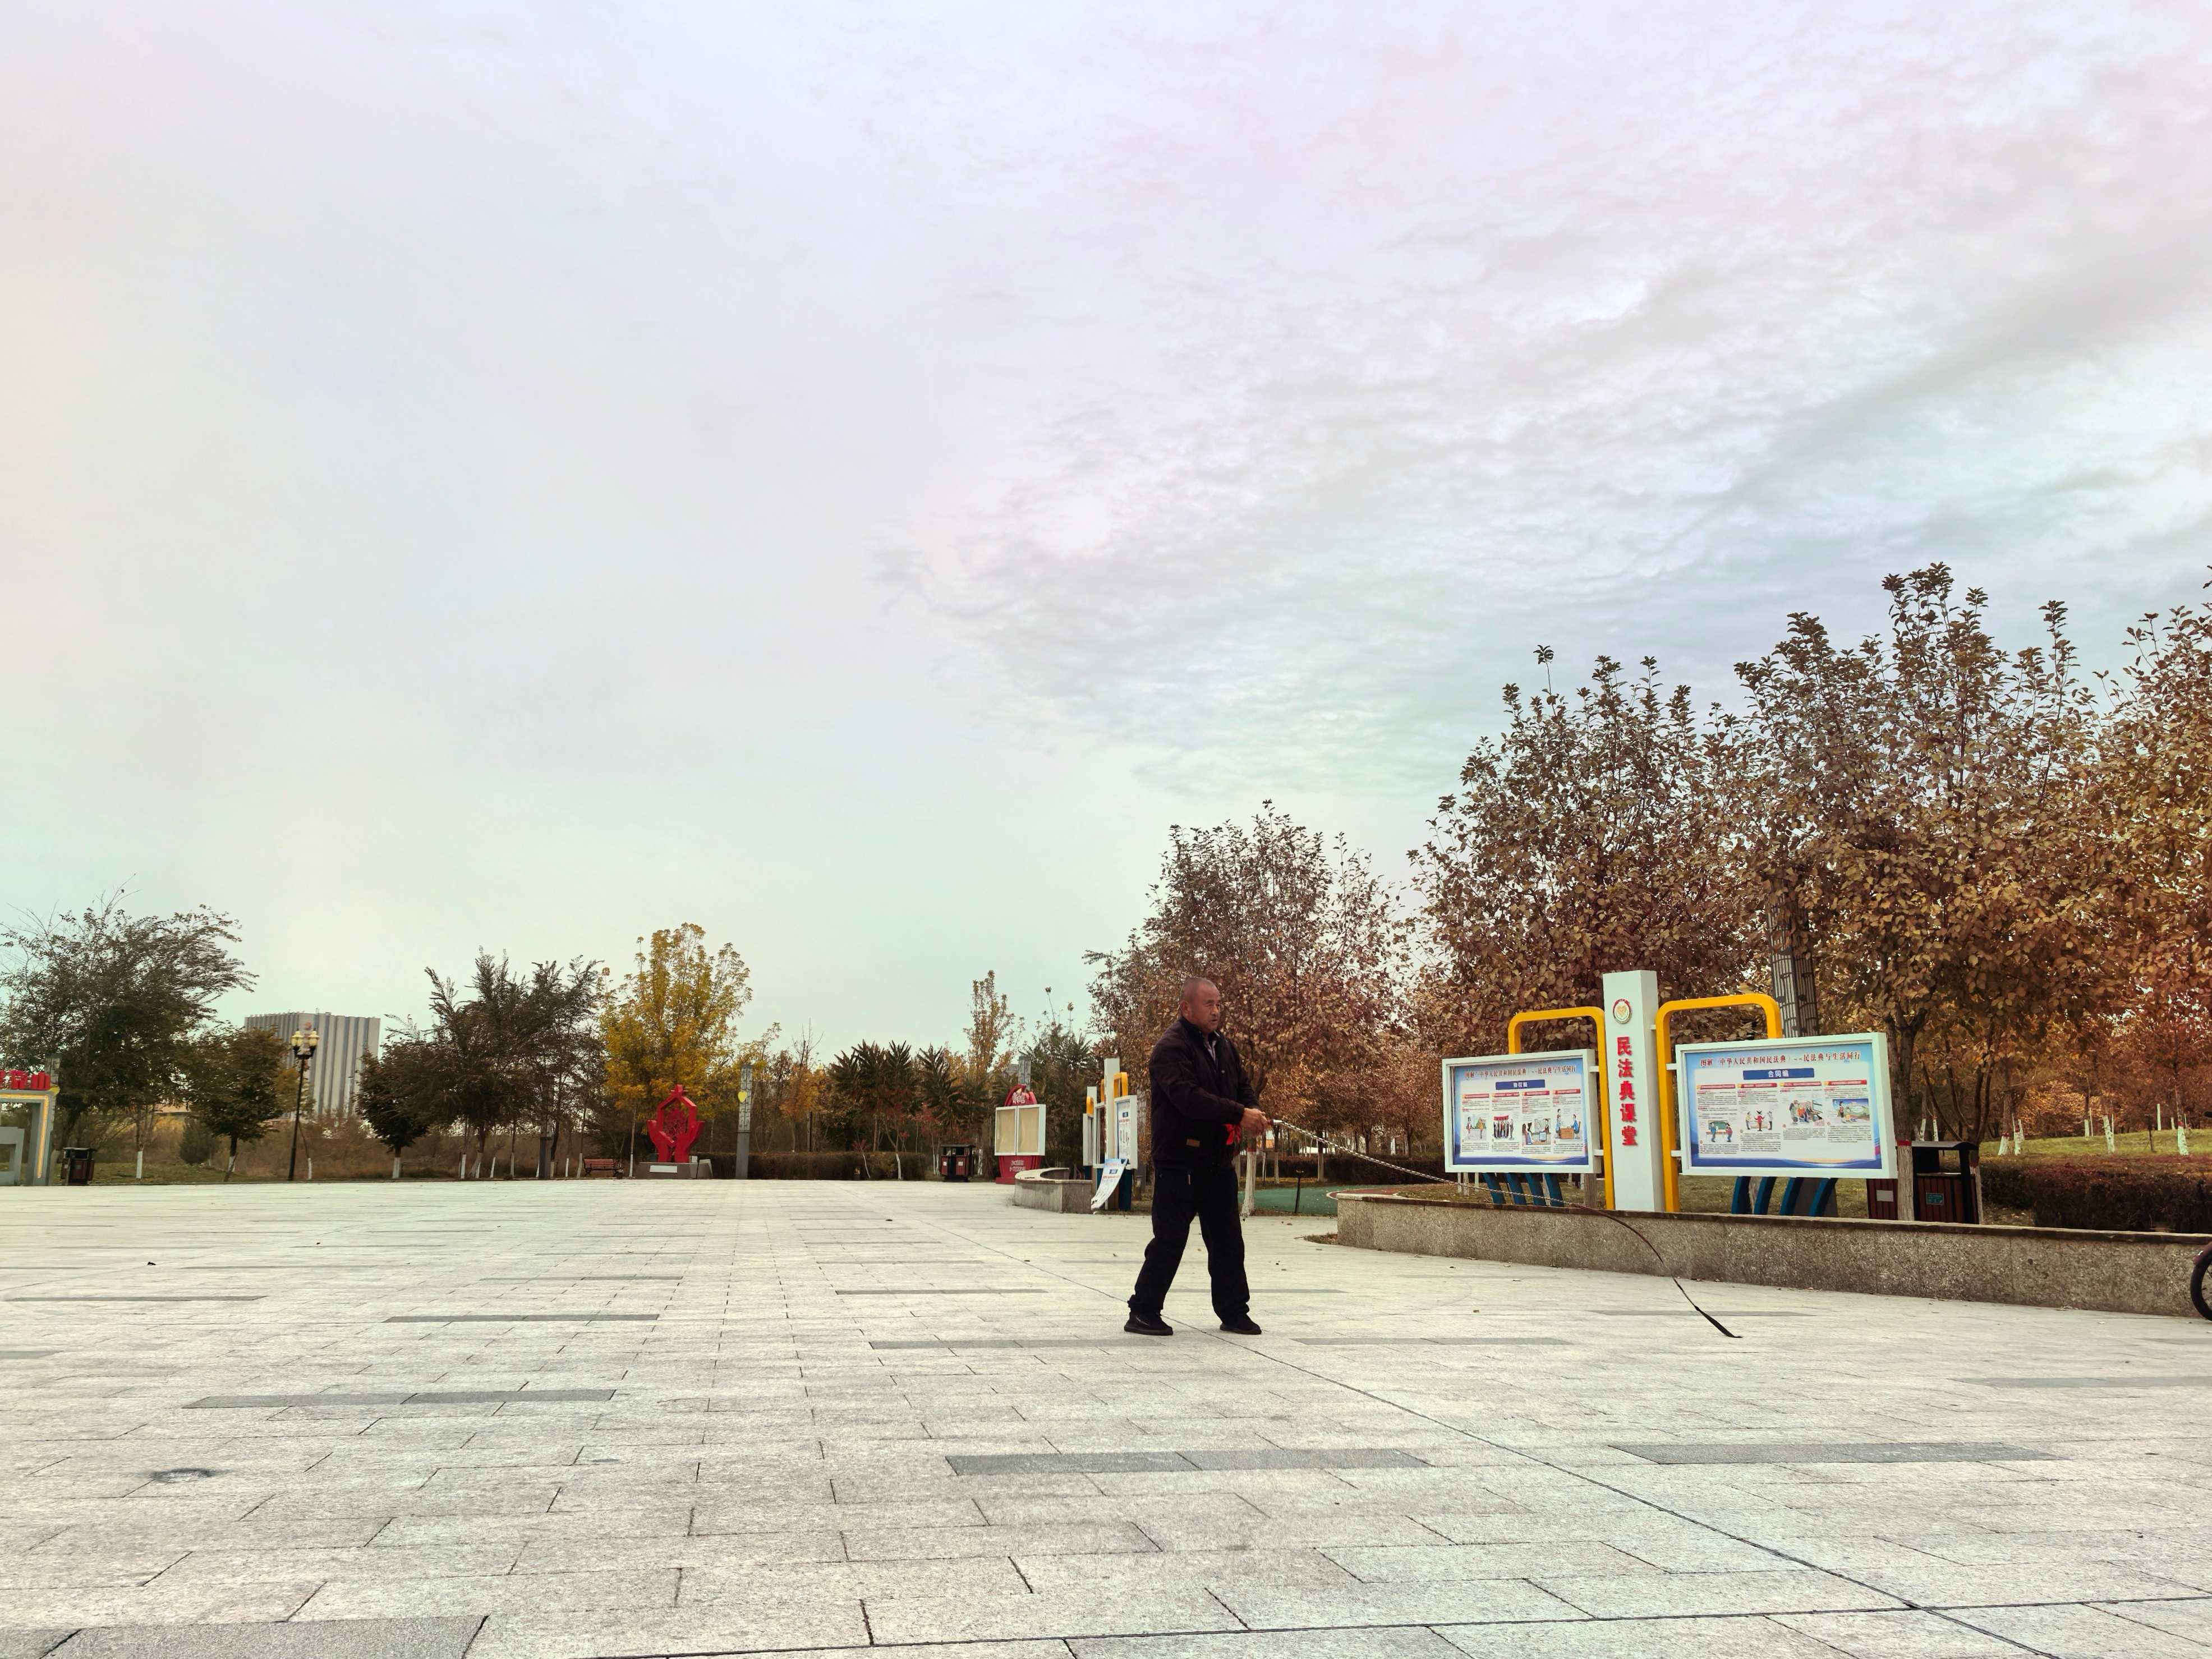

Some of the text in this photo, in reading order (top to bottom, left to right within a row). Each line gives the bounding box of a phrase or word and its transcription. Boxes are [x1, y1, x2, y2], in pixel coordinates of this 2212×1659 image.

[1617, 1036, 1638, 1146] 民法典课堂
